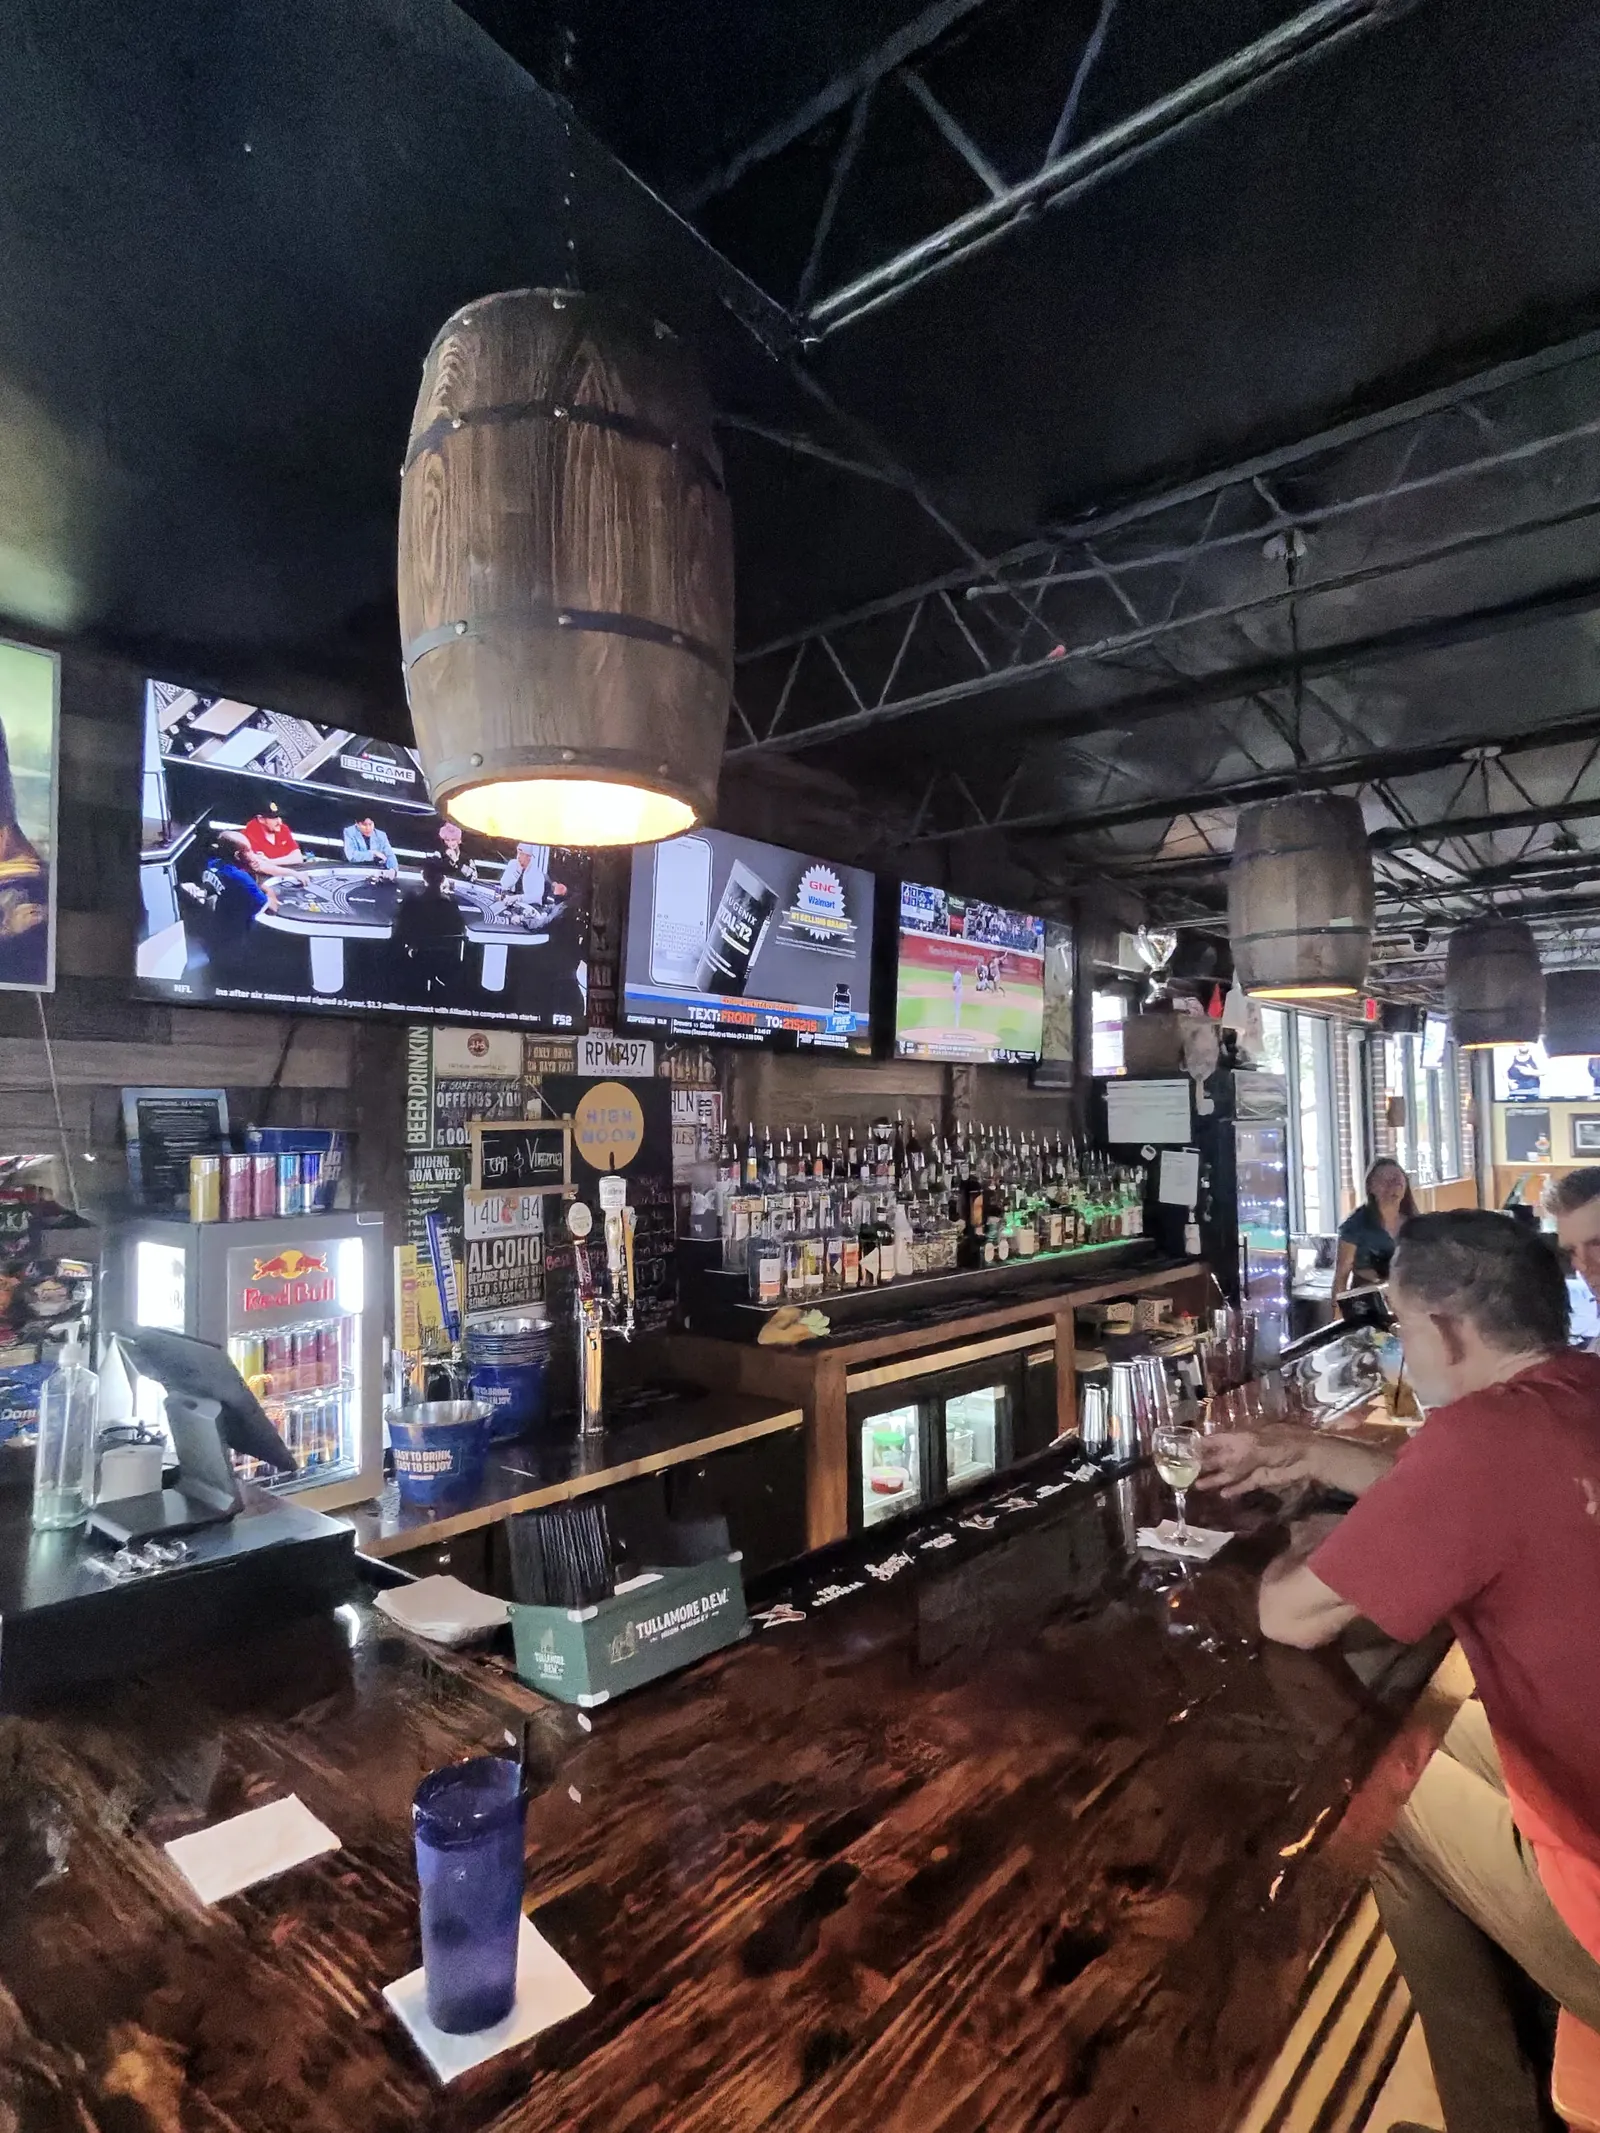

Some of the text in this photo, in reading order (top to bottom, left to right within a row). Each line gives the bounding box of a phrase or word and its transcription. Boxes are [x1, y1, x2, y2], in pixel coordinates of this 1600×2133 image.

[376, 766, 413, 780] GAME
[809, 880, 836, 894] GNC
[808, 895, 836, 909] Walmart
[174, 984, 193, 993] NFL
[688, 1006, 757, 1025] TEXT: FRONT
[765, 1015, 783, 1028] TO:
[407, 1026, 428, 1143] BEER DRINKIN
[436, 1091, 521, 1108] OFFENDS YOU
[408, 1167, 462, 1181] ROM WIFE
[468, 1236, 541, 1273] ALCOHO
[243, 1278, 336, 1312] Red Bull
[410, 1450, 421, 1460] TO
[412, 1461, 422, 1472] TO
[635, 1600, 700, 1639] TULLAMORE
